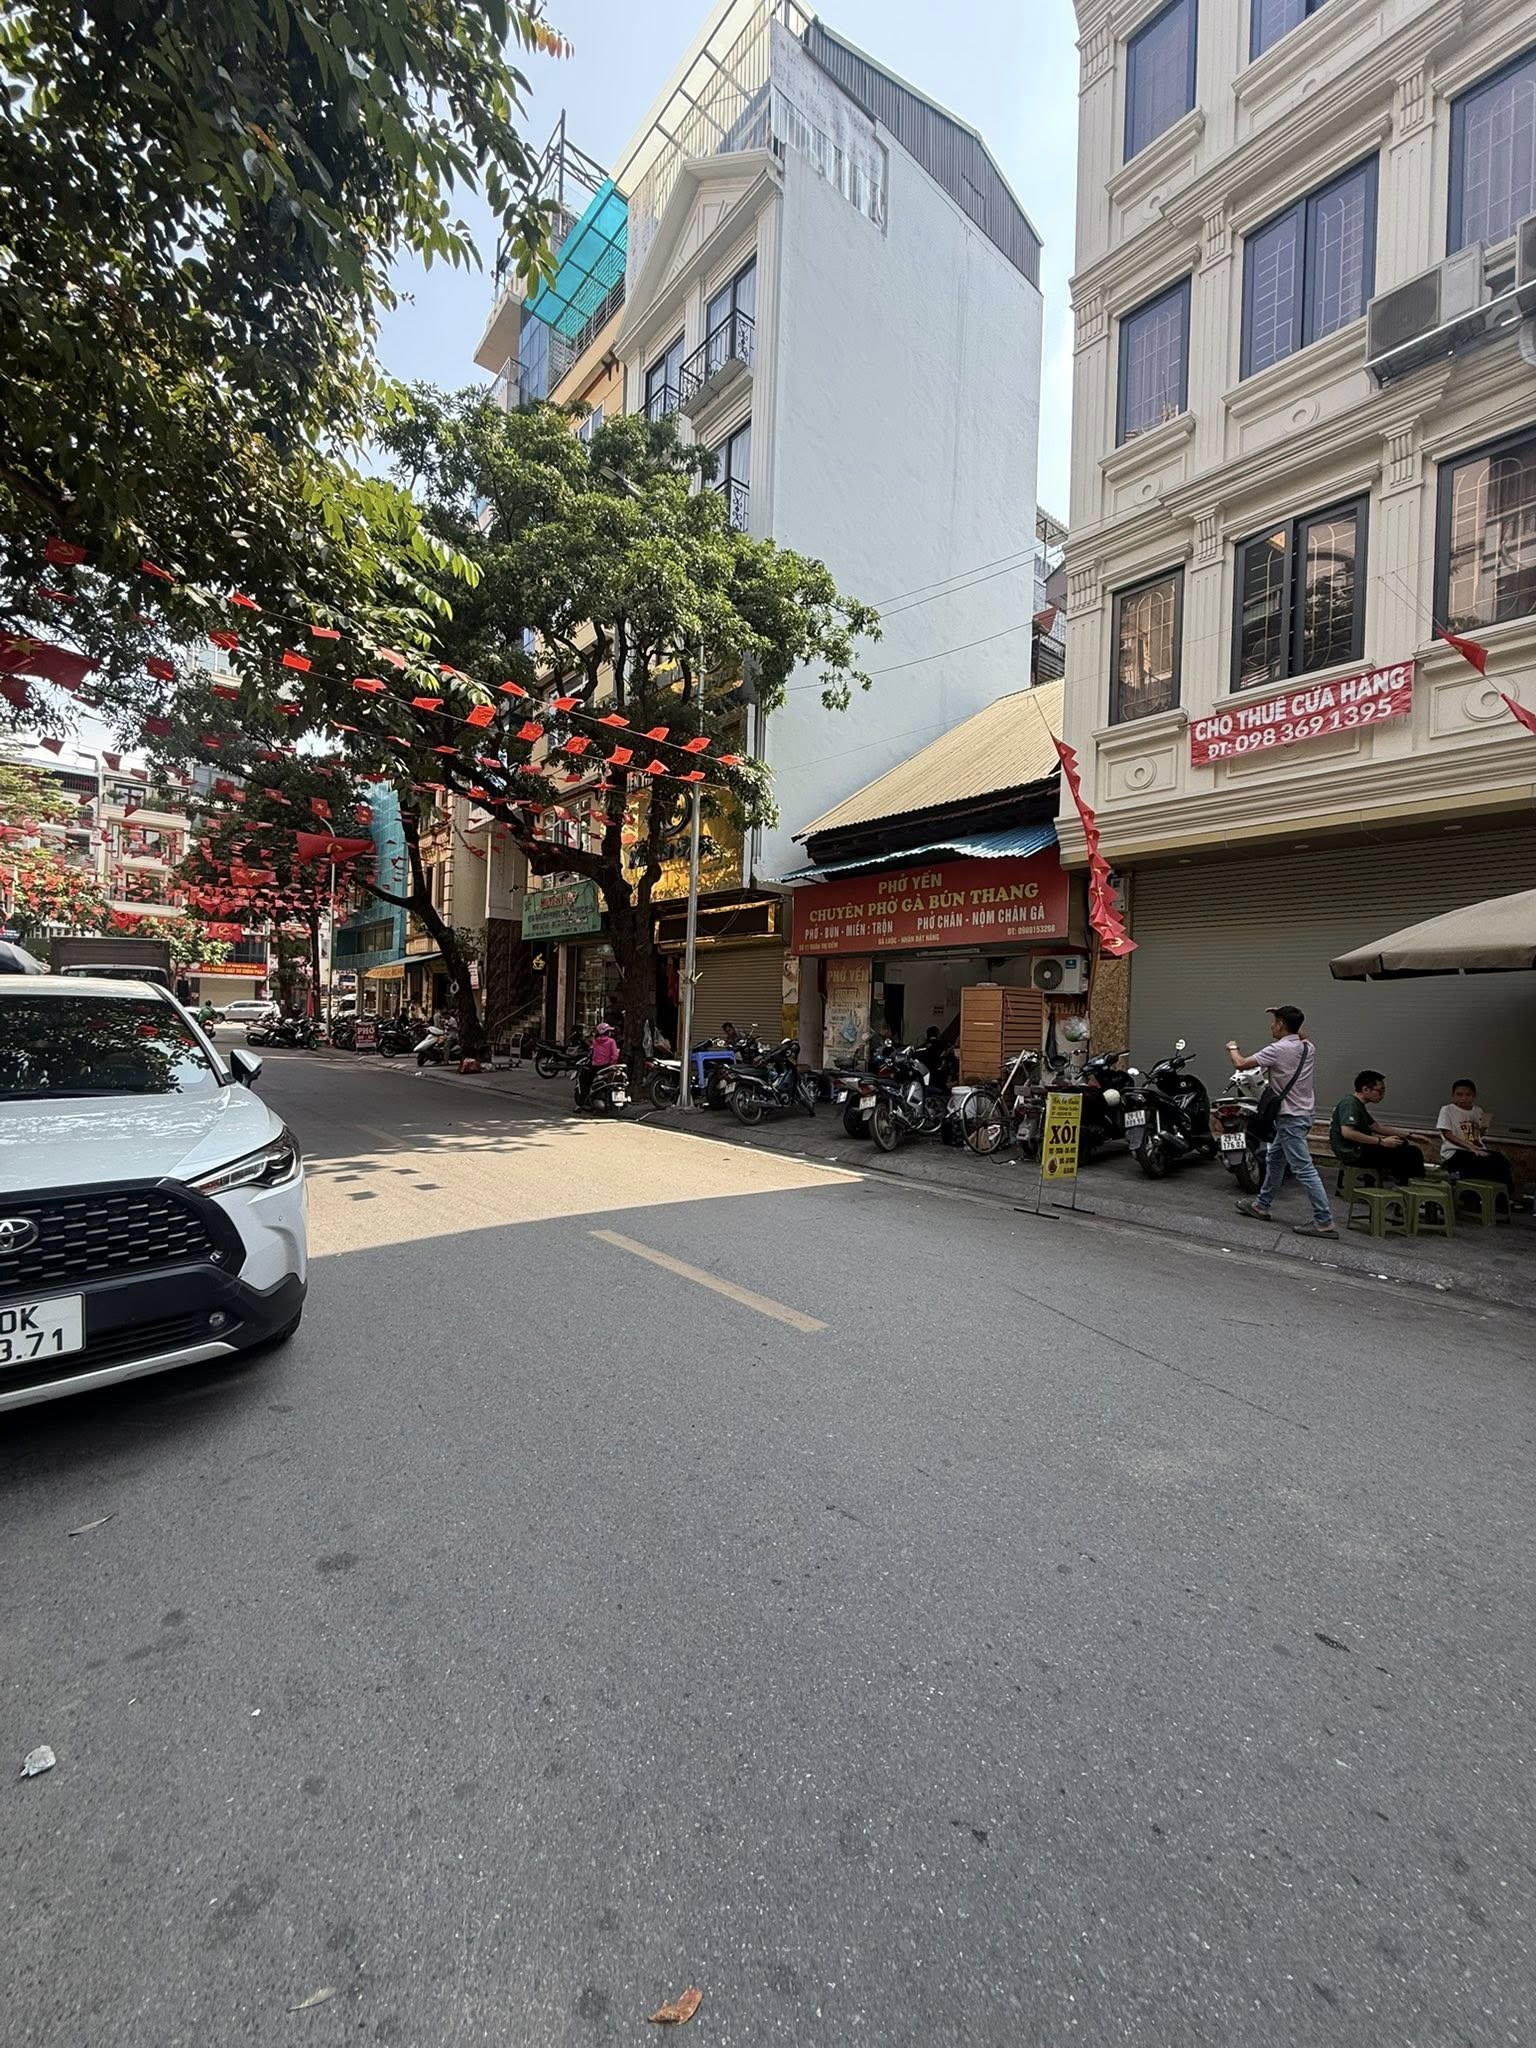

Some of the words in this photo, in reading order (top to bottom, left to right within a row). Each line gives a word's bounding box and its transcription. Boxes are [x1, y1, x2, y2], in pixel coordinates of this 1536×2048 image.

[1194, 716, 1233, 742] CHO
[1236, 695, 1287, 730] THUÊ
[1291, 685, 1335, 716] CỬA
[1340, 667, 1406, 704] HÀNG
[1208, 742, 1232, 759] ĐT:
[1235, 727, 1276, 752] 098
[1279, 716, 1324, 742] 369
[1329, 697, 1393, 730] 1395
[878, 873, 908, 895] PHỞ
[912, 870, 943, 890] YẾN
[809, 902, 865, 922] CHUYÊN
[867, 895, 898, 916] PHỞ
[901, 893, 925, 912] GÀ
[928, 890, 965, 909] BÚN
[969, 882, 1040, 905] THANG
[917, 910, 936, 931] PHỞ
[972, 908, 995, 927] NỘM
[998, 905, 1027, 924] CHÂN
[1030, 902, 1045, 921] GÀ
[804, 923, 819, 941] PHỞ
[825, 924, 839, 939] BÚN
[357, 1024, 376, 1035] PHỞ
[1049, 1119, 1077, 1144] XÔI
